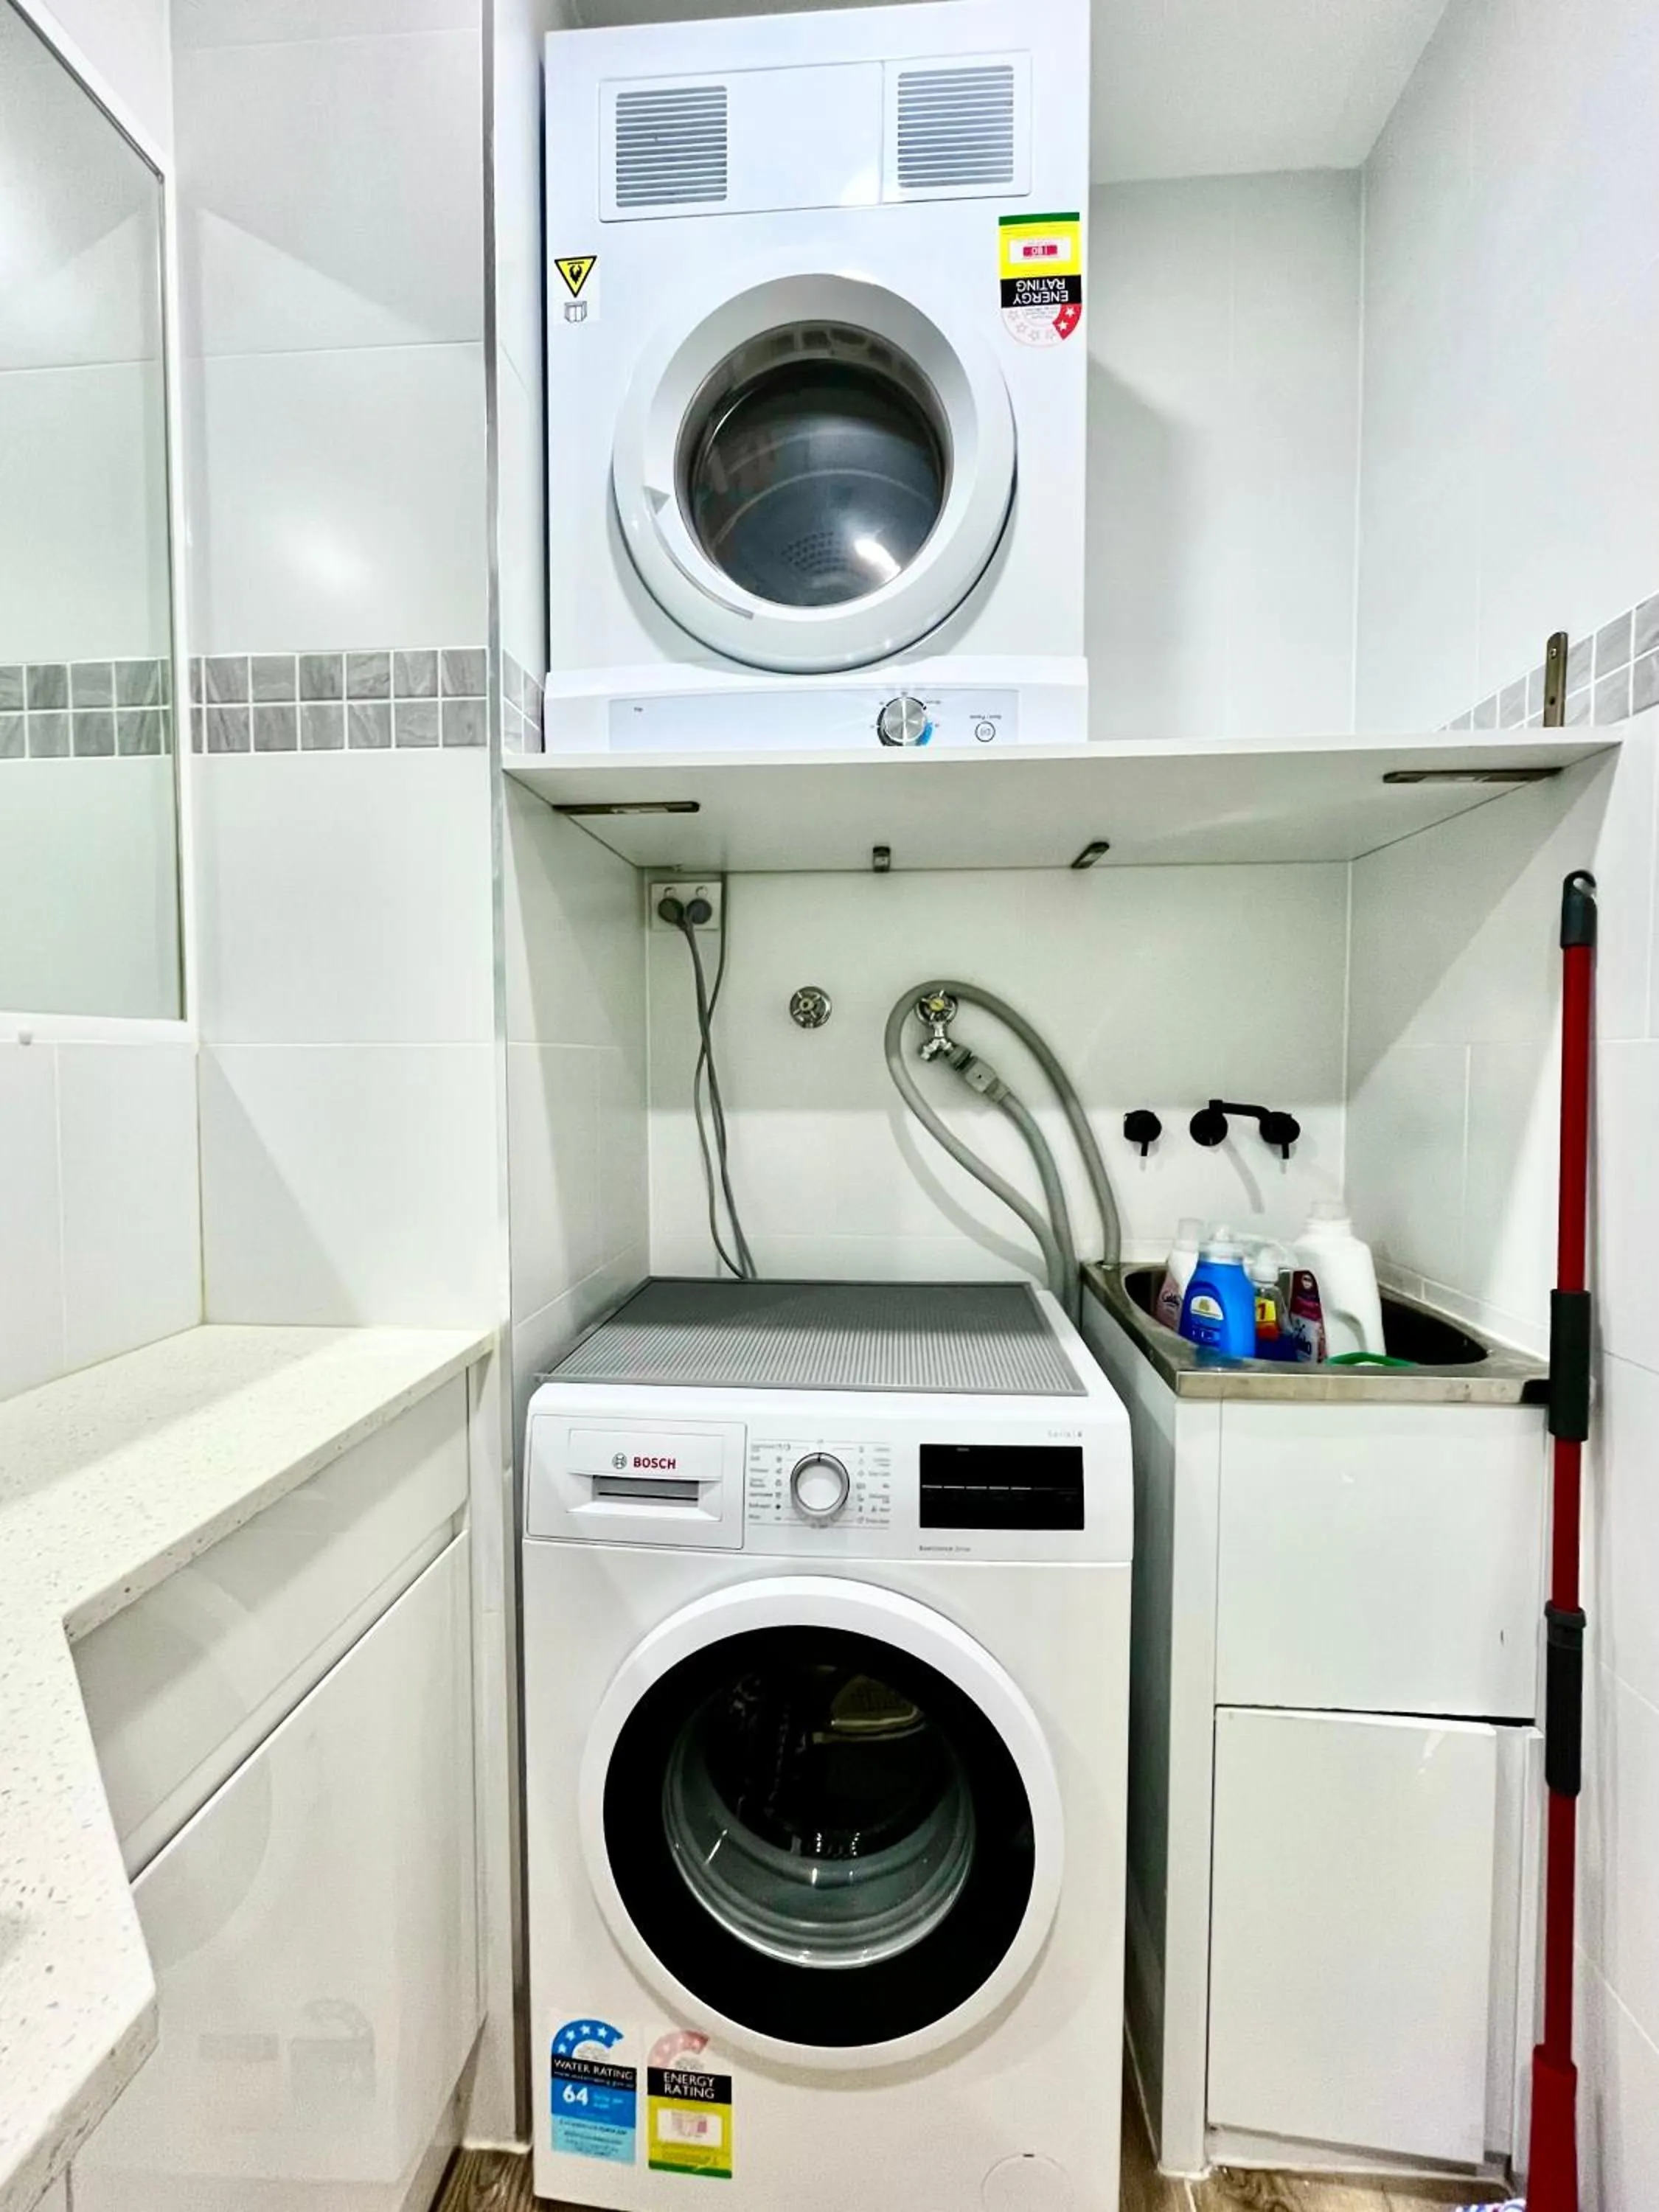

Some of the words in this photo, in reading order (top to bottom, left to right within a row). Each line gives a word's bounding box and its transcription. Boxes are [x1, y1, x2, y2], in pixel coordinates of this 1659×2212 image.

[1016, 279, 1065, 292] RATING
[1013, 291, 1068, 305] ENERGY
[633, 1456, 677, 1470] BOSCH
[554, 2059, 591, 2074] WATER
[594, 2065, 633, 2081] RATING
[663, 2071, 715, 2088] ENERGY
[563, 2084, 588, 2107] 64
[664, 2083, 715, 2100] RATING
